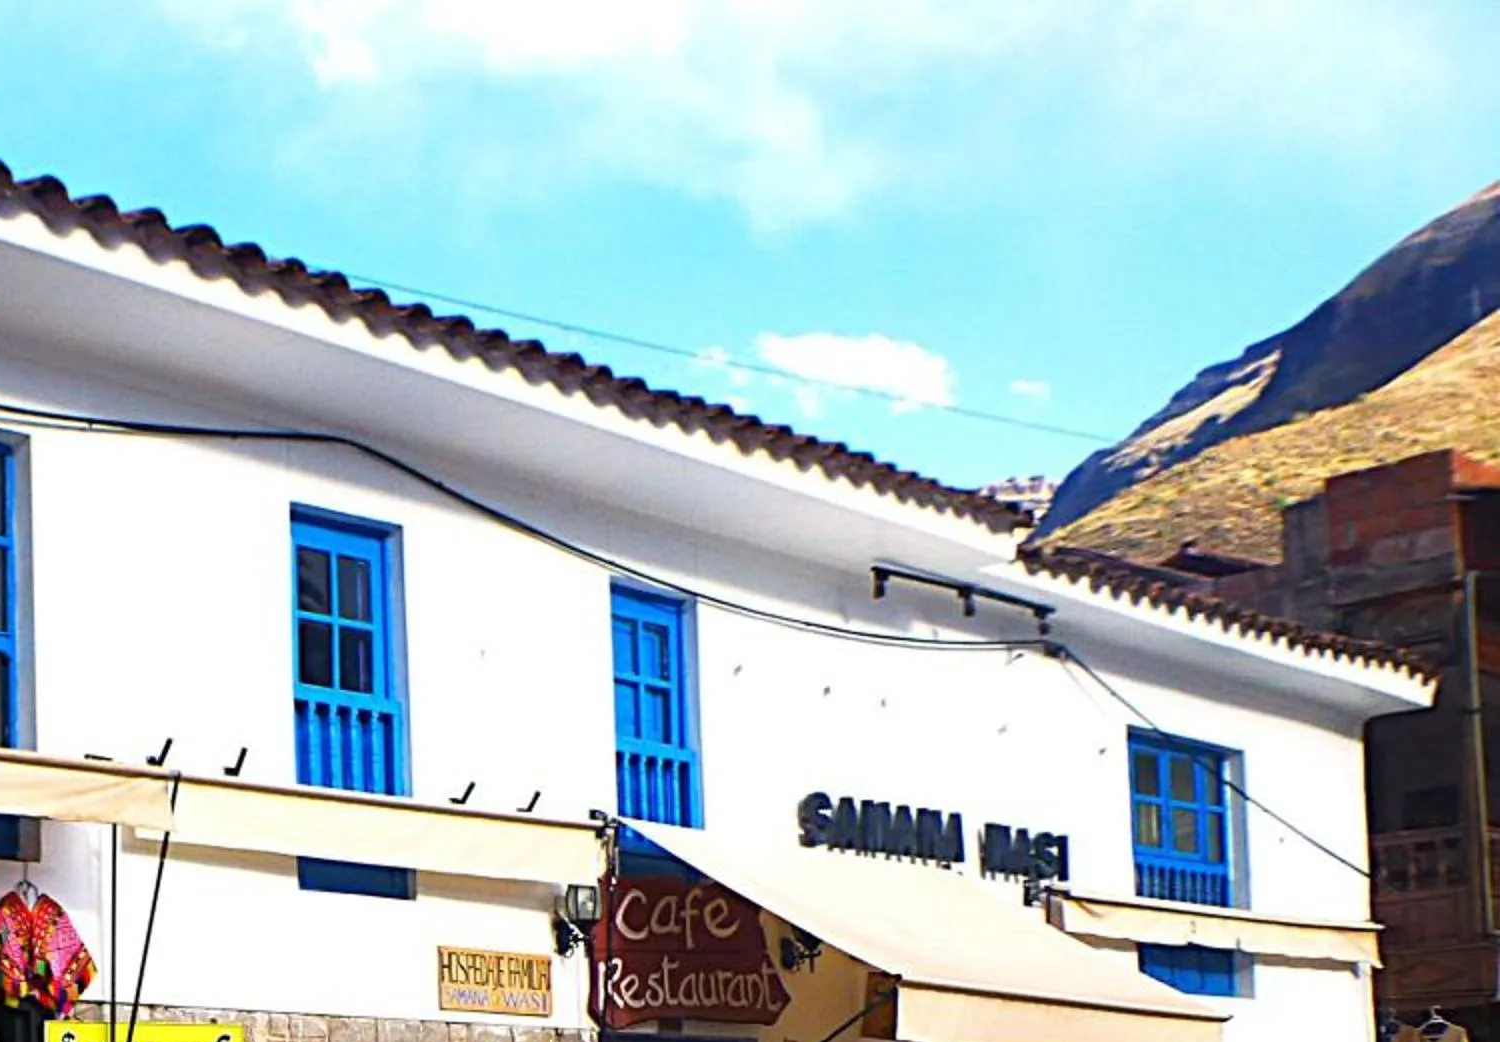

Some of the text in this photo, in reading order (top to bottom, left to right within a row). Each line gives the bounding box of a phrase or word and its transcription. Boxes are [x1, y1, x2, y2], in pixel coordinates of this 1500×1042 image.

[798, 792, 1069, 882] SAMANA WASI
[615, 887, 741, 949] Cafe
[598, 954, 780, 1011] Restaurant
